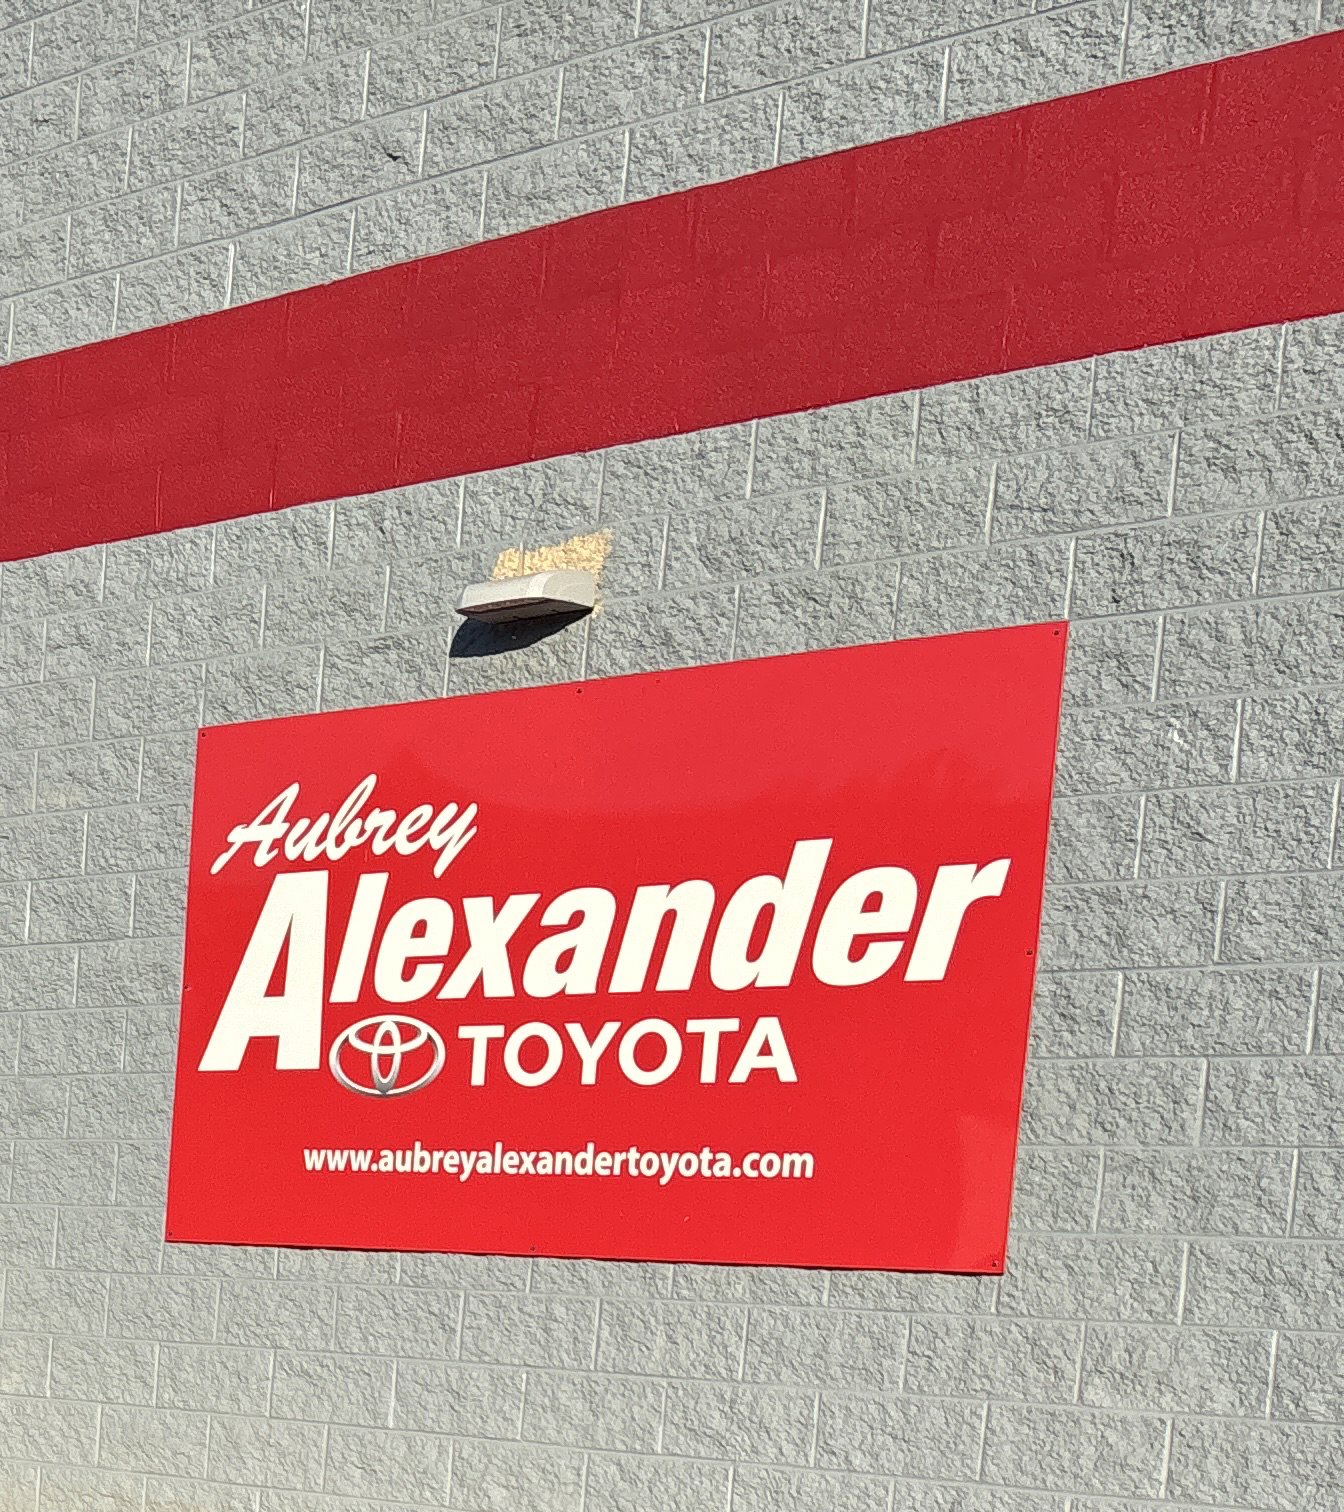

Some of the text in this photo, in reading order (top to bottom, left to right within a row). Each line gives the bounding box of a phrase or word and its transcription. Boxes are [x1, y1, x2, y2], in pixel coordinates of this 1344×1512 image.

[211, 774, 478, 878] Aubrey
[198, 838, 1011, 1072] Alexander
[457, 1017, 798, 1086] TOYOTA
[303, 1142, 814, 1185] www.aubreyalexandertoyota.com
